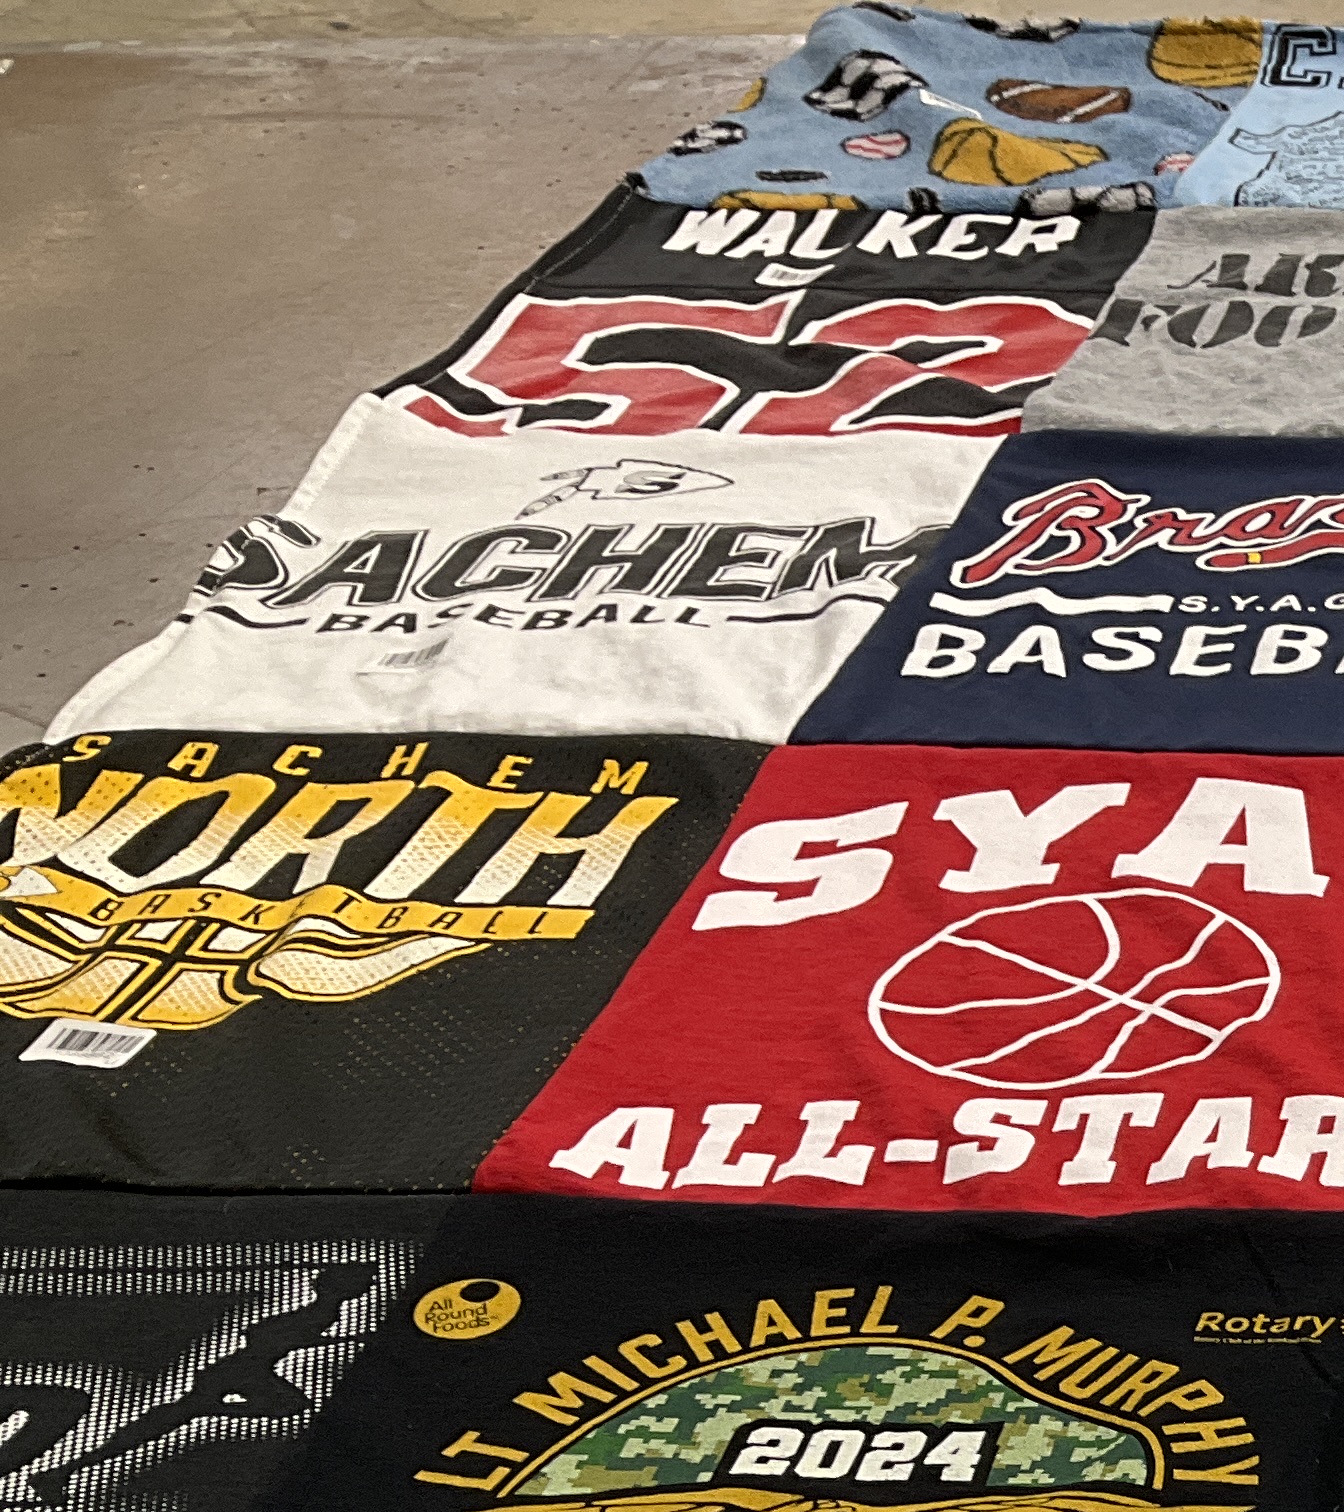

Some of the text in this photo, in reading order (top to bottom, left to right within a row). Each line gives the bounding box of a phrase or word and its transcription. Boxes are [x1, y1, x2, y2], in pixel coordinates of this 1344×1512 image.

[662, 208, 1080, 260] WALKER
[400, 290, 1100, 440] 52
[315, 602, 713, 635] BASEBALL
[62, 733, 651, 797] SACHEM
[87, 891, 548, 937] BASKTBALL
[424, 1303, 489, 1324] Round
[429, 1298, 453, 1312] All
[432, 1316, 491, 1334] Foods
[1195, 1311, 1337, 1339] Rotary
[413, 1285, 1260, 1491] LT MICHAEL P. MURPHY
[729, 1426, 988, 1482] 2024
